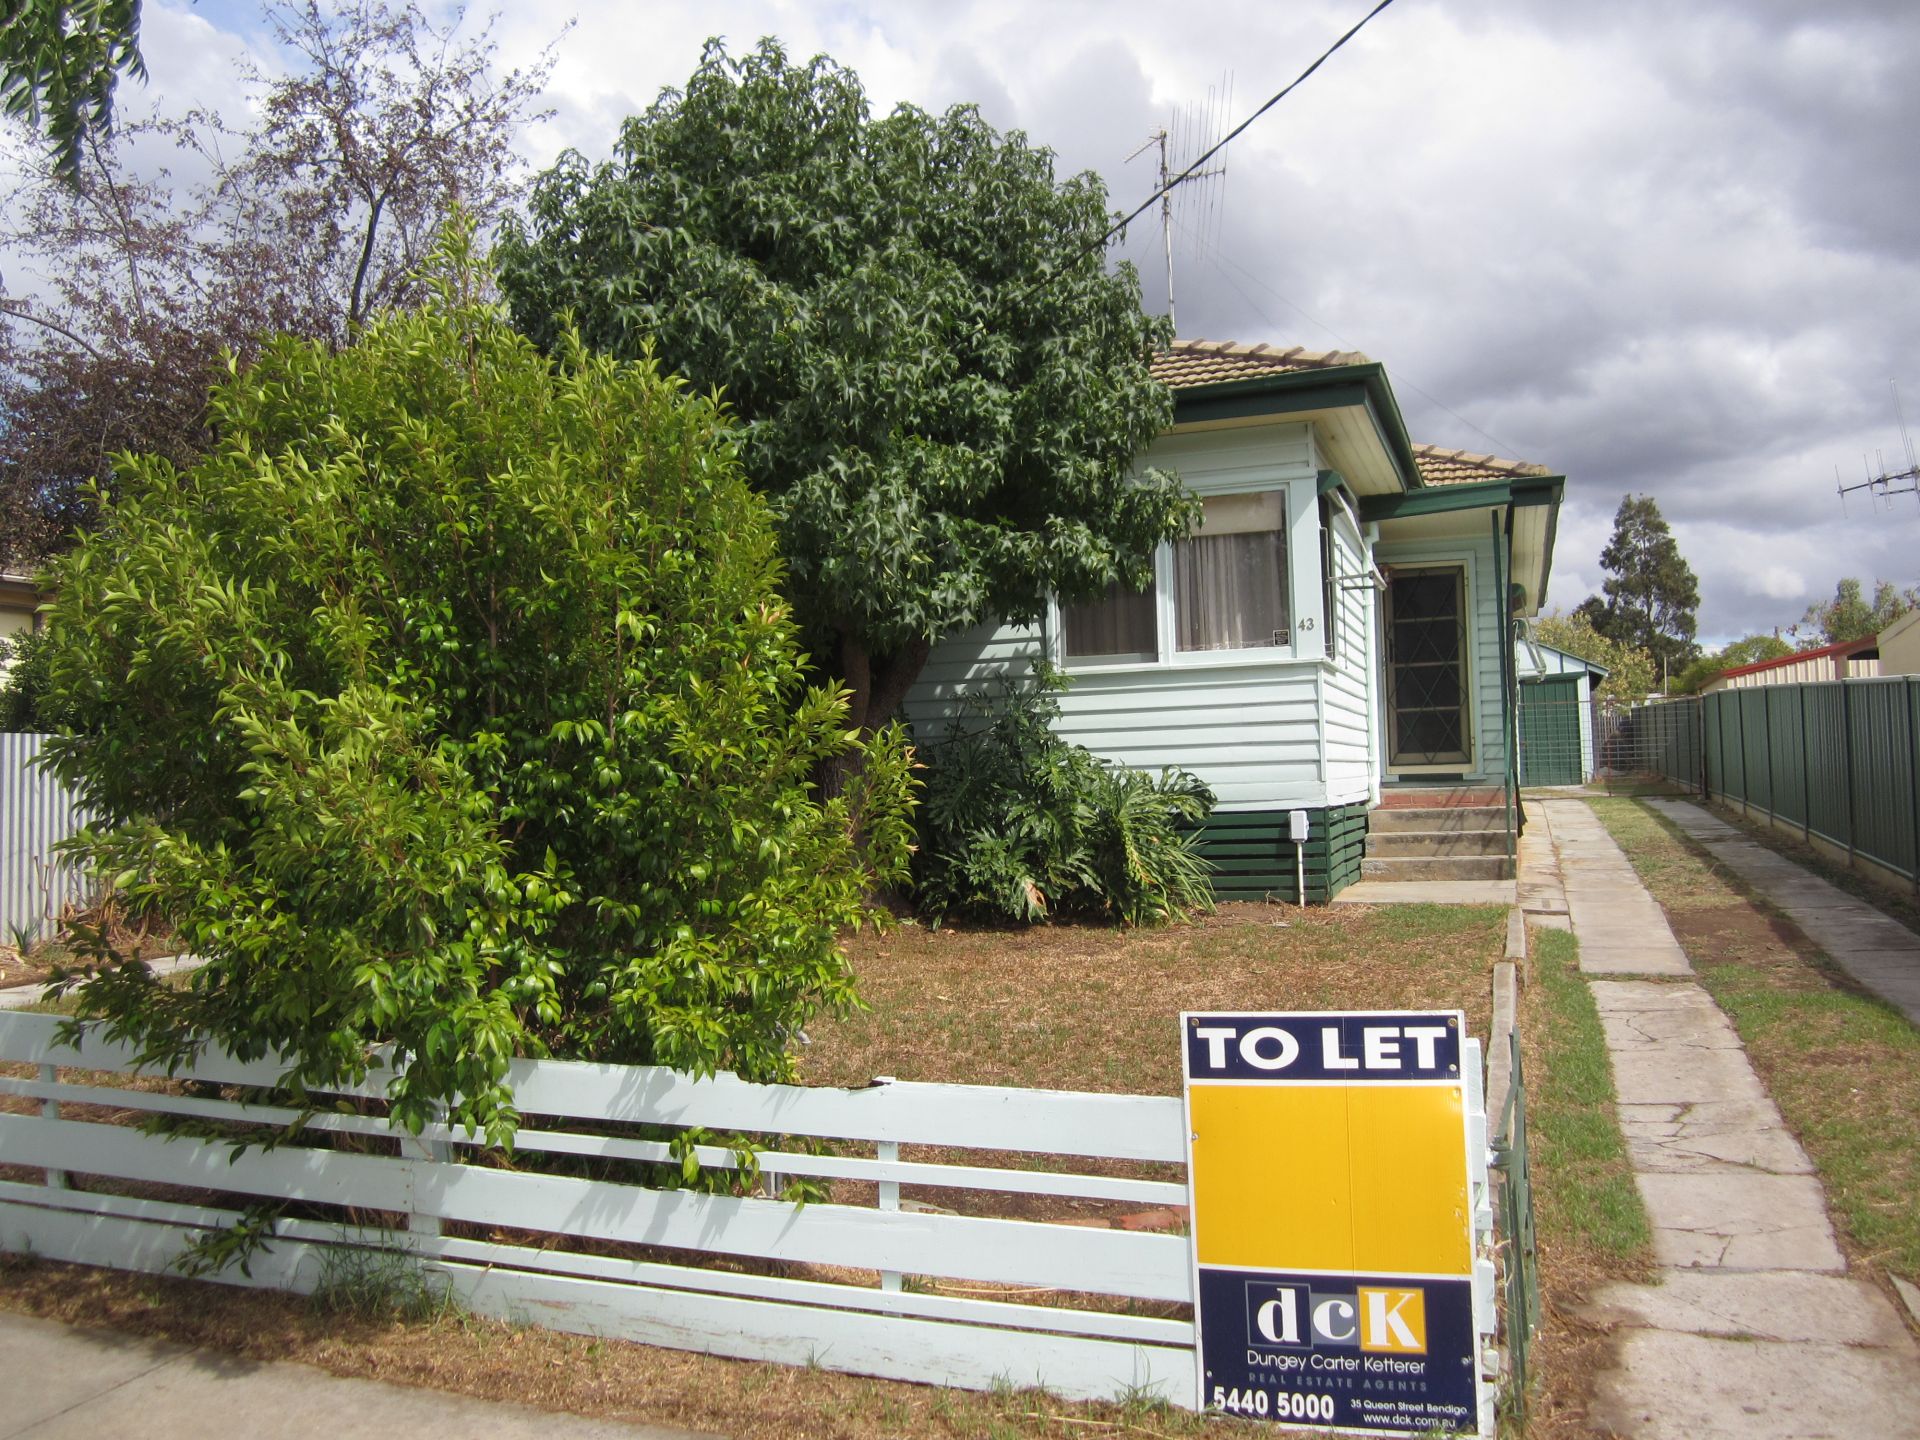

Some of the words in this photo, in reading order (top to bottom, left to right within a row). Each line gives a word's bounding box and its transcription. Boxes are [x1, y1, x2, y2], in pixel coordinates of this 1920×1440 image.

[1297, 617, 1315, 632] 43
[1196, 1027, 1300, 1070] TO
[1321, 1026, 1448, 1070] LET
[1247, 1350, 1307, 1371] Dungey
[1310, 1354, 1359, 1371] Carter
[1364, 1356, 1426, 1374] Ketterer
[1248, 1372, 1286, 1384] REAL
[1296, 1376, 1353, 1388] ESTATE
[1363, 1379, 1427, 1392] AGENTS
[1213, 1385, 1269, 1415] 5440
[1276, 1391, 1335, 1420] 5000
[1350, 1399, 1362, 1409] 35
[1363, 1399, 1396, 1411] Queen
[1397, 1401, 1424, 1412] Street
[1427, 1403, 1468, 1416] Bendigo
[1363, 1413, 1456, 1428] www.dck.com.au
